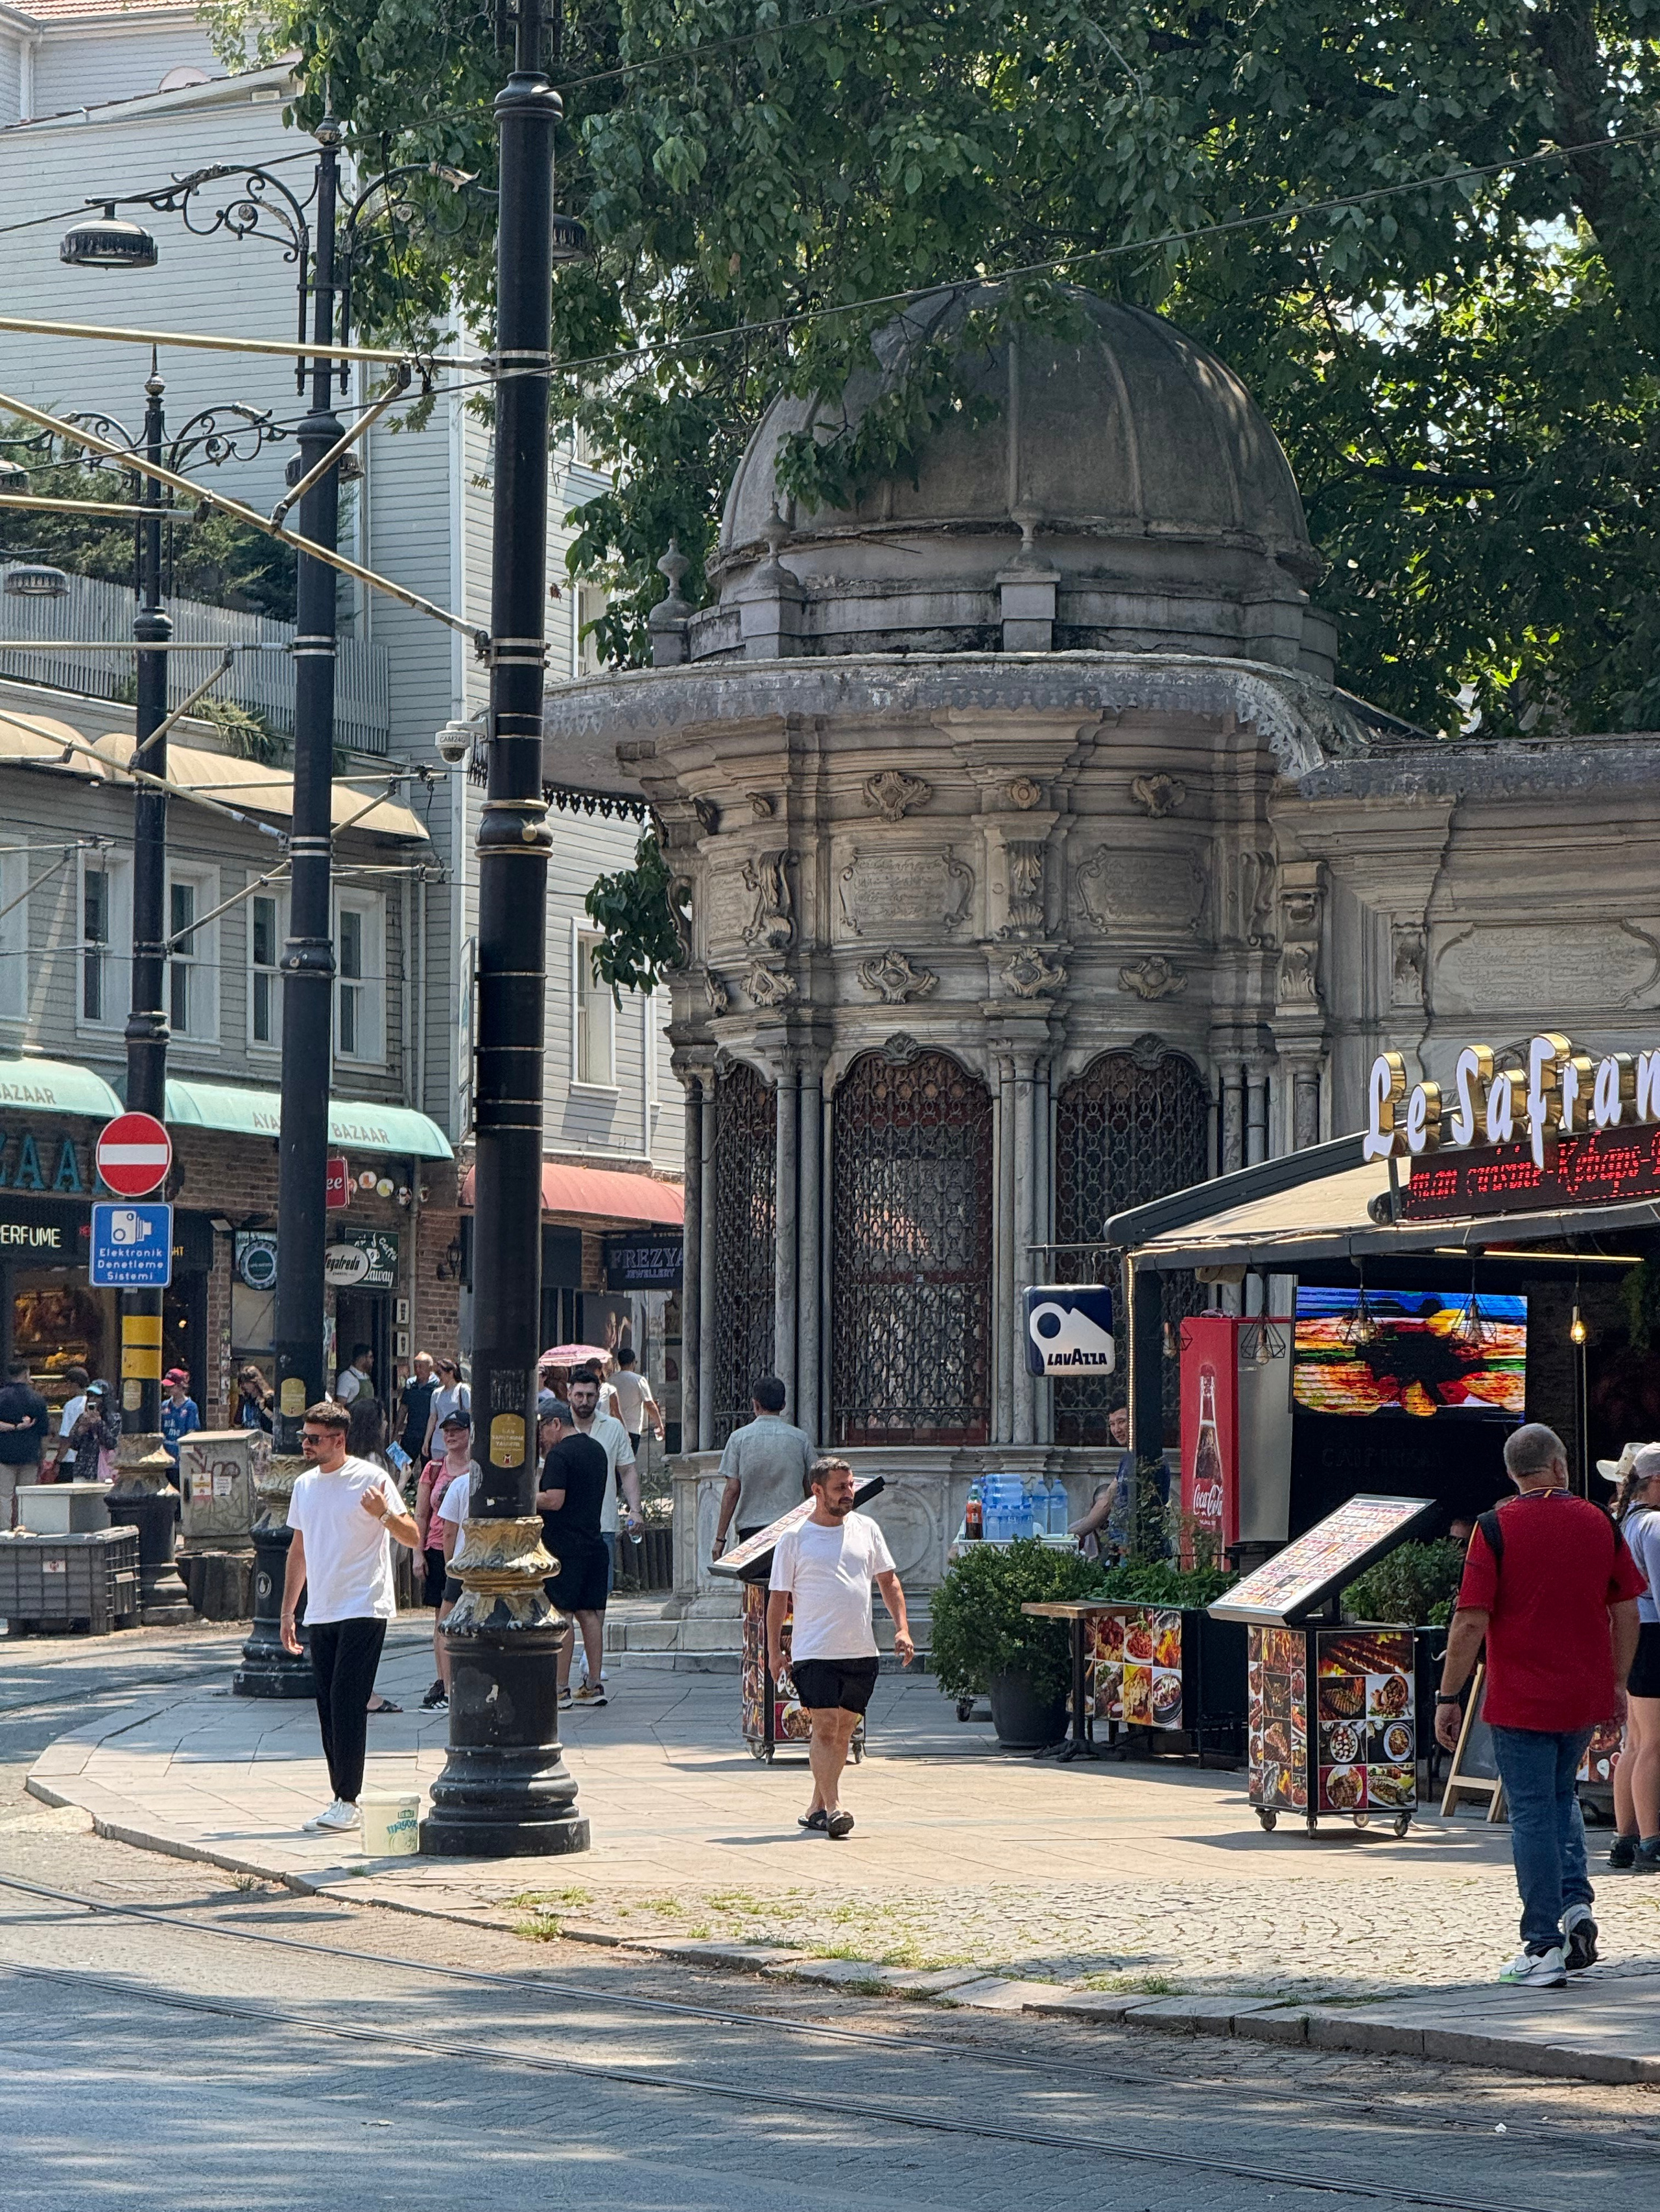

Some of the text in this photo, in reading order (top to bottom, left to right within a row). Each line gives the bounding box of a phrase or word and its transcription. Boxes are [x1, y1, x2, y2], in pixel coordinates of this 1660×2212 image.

[0, 1083, 56, 1105] AZAAR
[1364, 1053, 1438, 1160] Le
[252, 1112, 390, 1144] AYA BAZAAR
[0, 1224, 62, 1248] ERFUME
[99, 1248, 162, 1257] Elektronik
[98, 1260, 163, 1269] Denetleme
[107, 1272, 153, 1280] Sistemi
[1047, 1348, 1108, 1365] LAVAZZA
